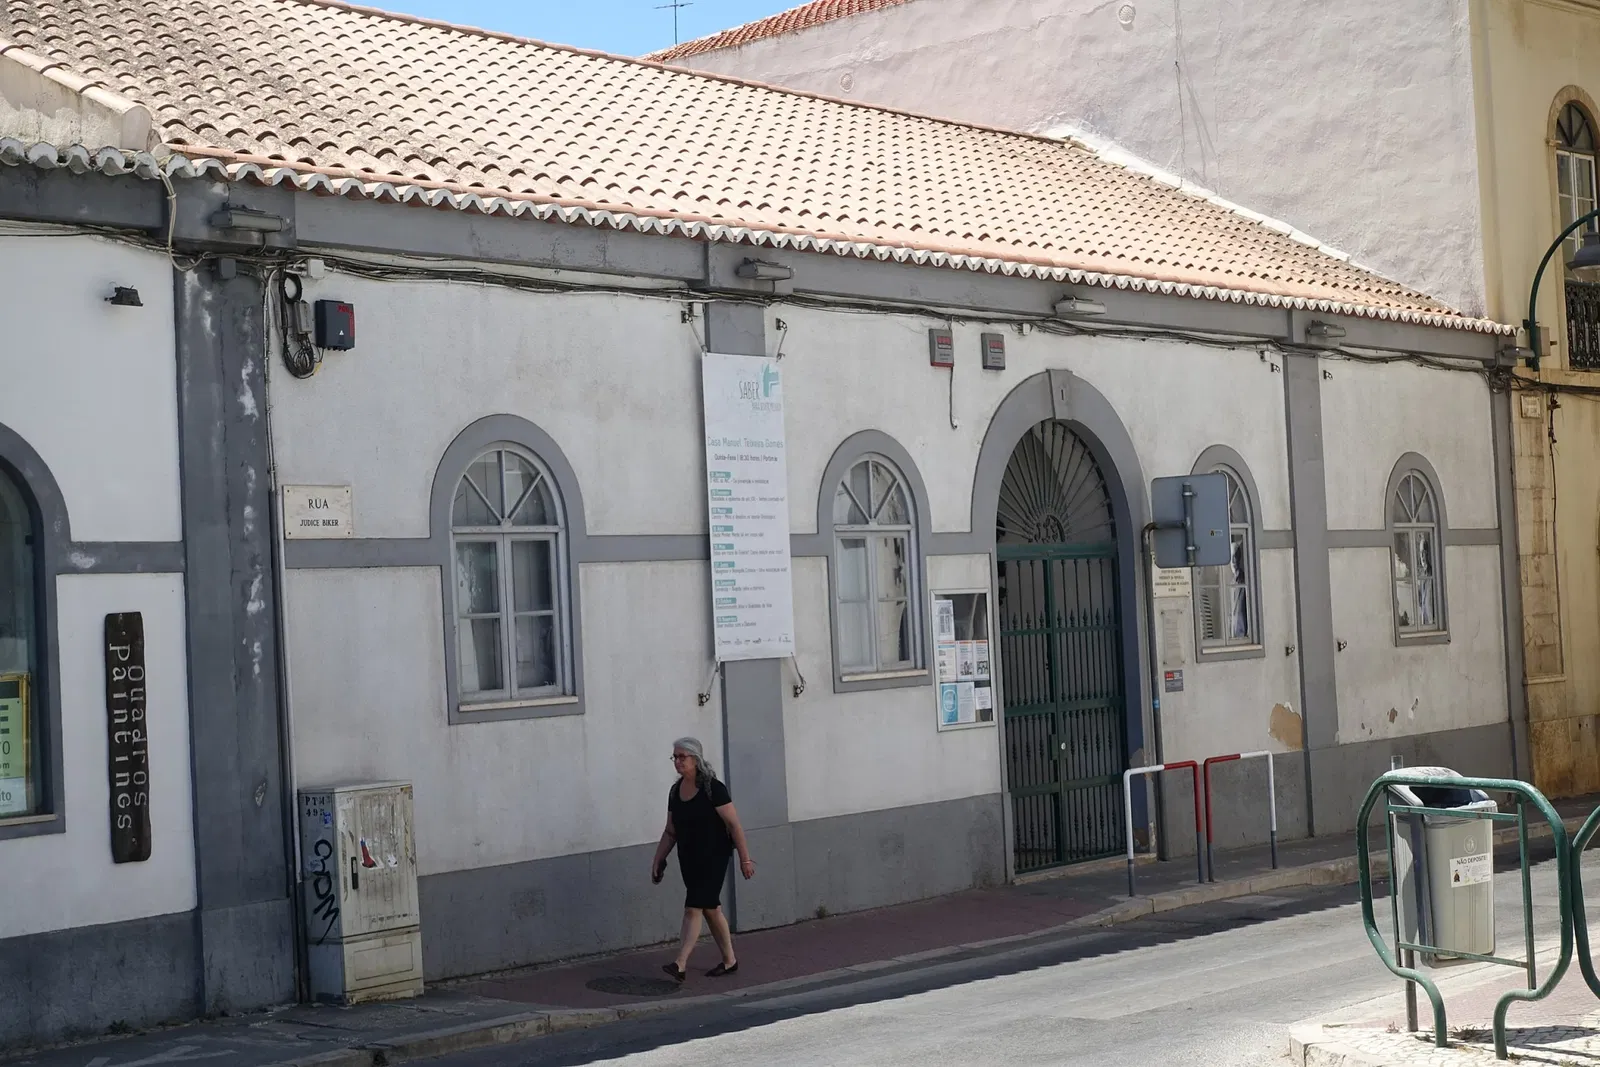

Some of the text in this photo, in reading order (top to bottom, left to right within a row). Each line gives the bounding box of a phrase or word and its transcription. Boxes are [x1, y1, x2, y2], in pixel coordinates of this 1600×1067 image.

[738, 380, 760, 400] SABER
[707, 436, 721, 447] Casa
[308, 498, 329, 509] RUA
[300, 519, 339, 527] JUDICE BIKER
[127, 665, 147, 807] Quadros
